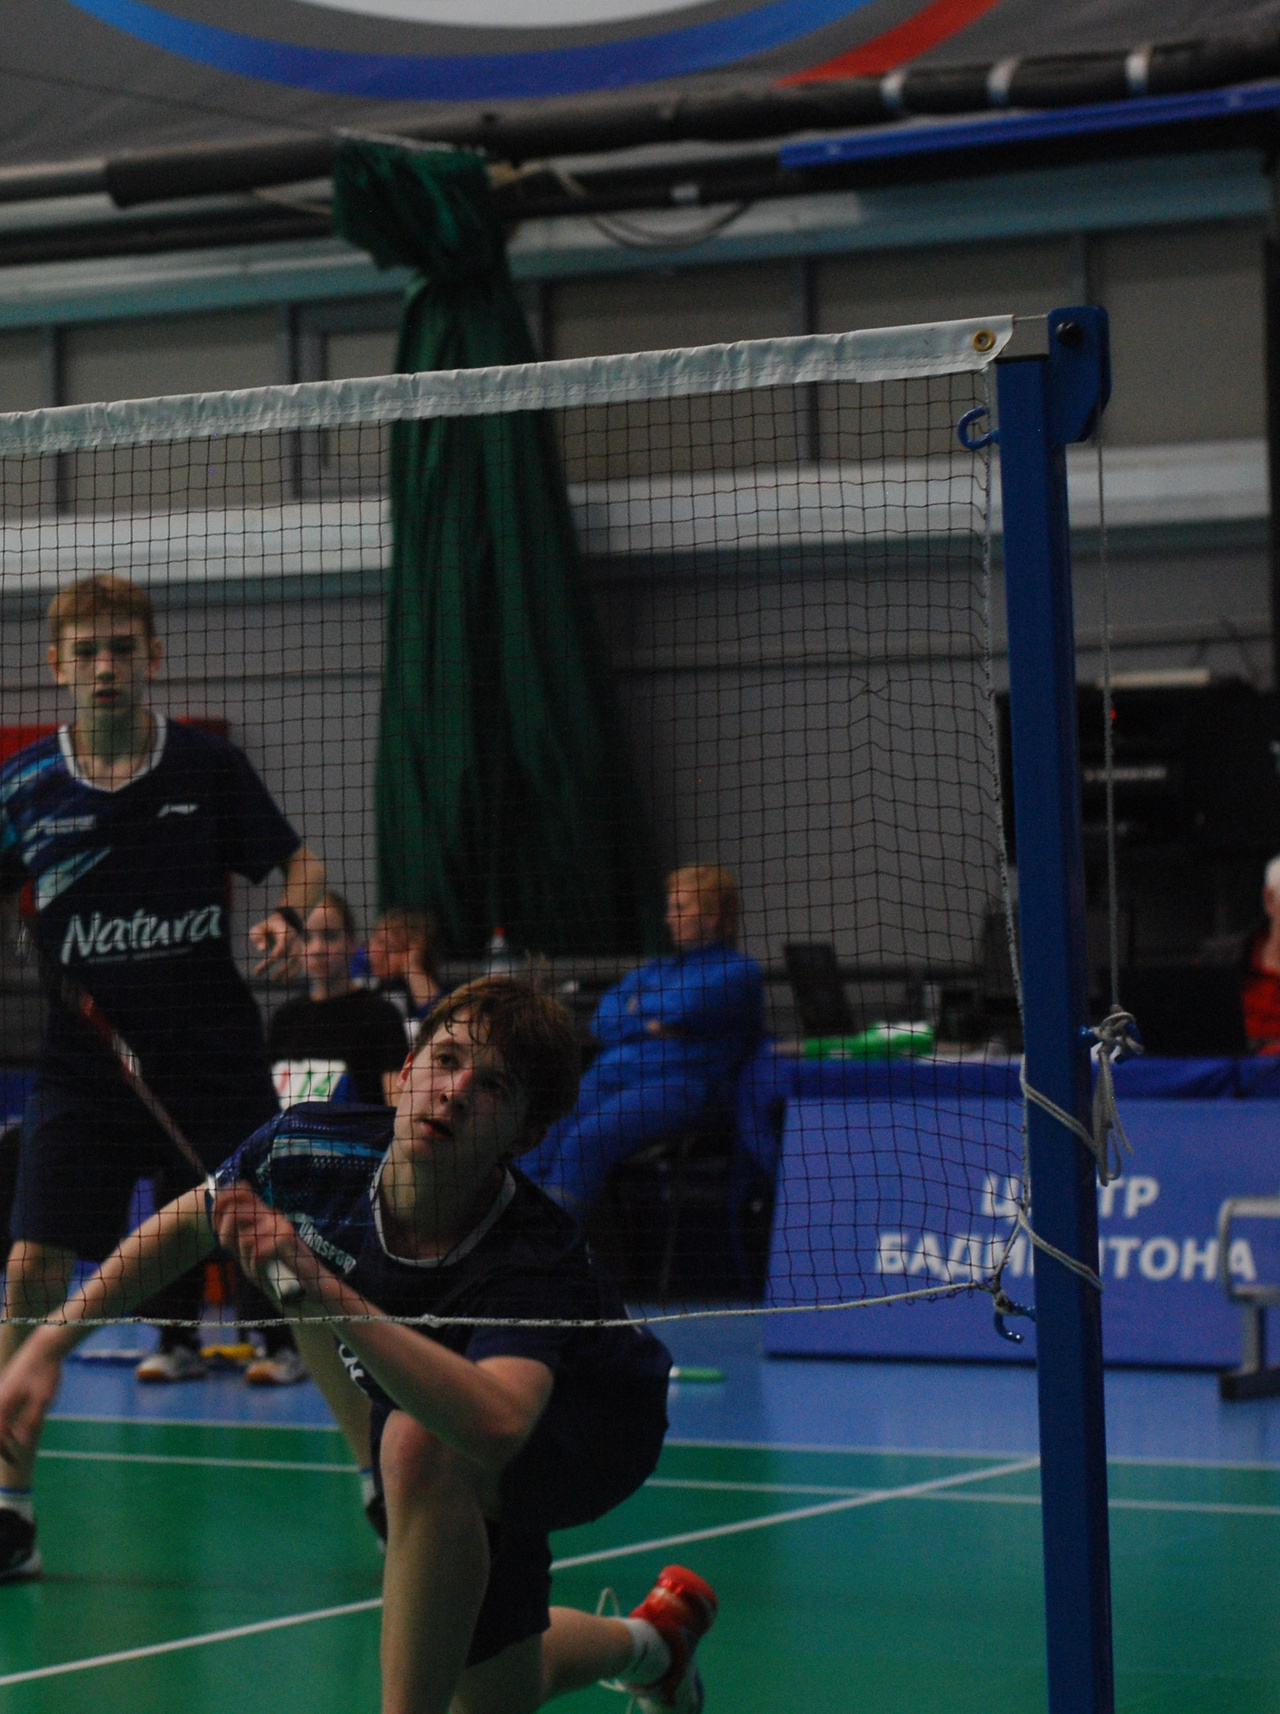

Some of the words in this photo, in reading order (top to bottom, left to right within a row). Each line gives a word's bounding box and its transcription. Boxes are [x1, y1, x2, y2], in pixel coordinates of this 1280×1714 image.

[60, 904, 222, 964] Natura
[982, 1174, 1160, 1222] ЦТР
[875, 1232, 1257, 1282] БАДМТОНА
